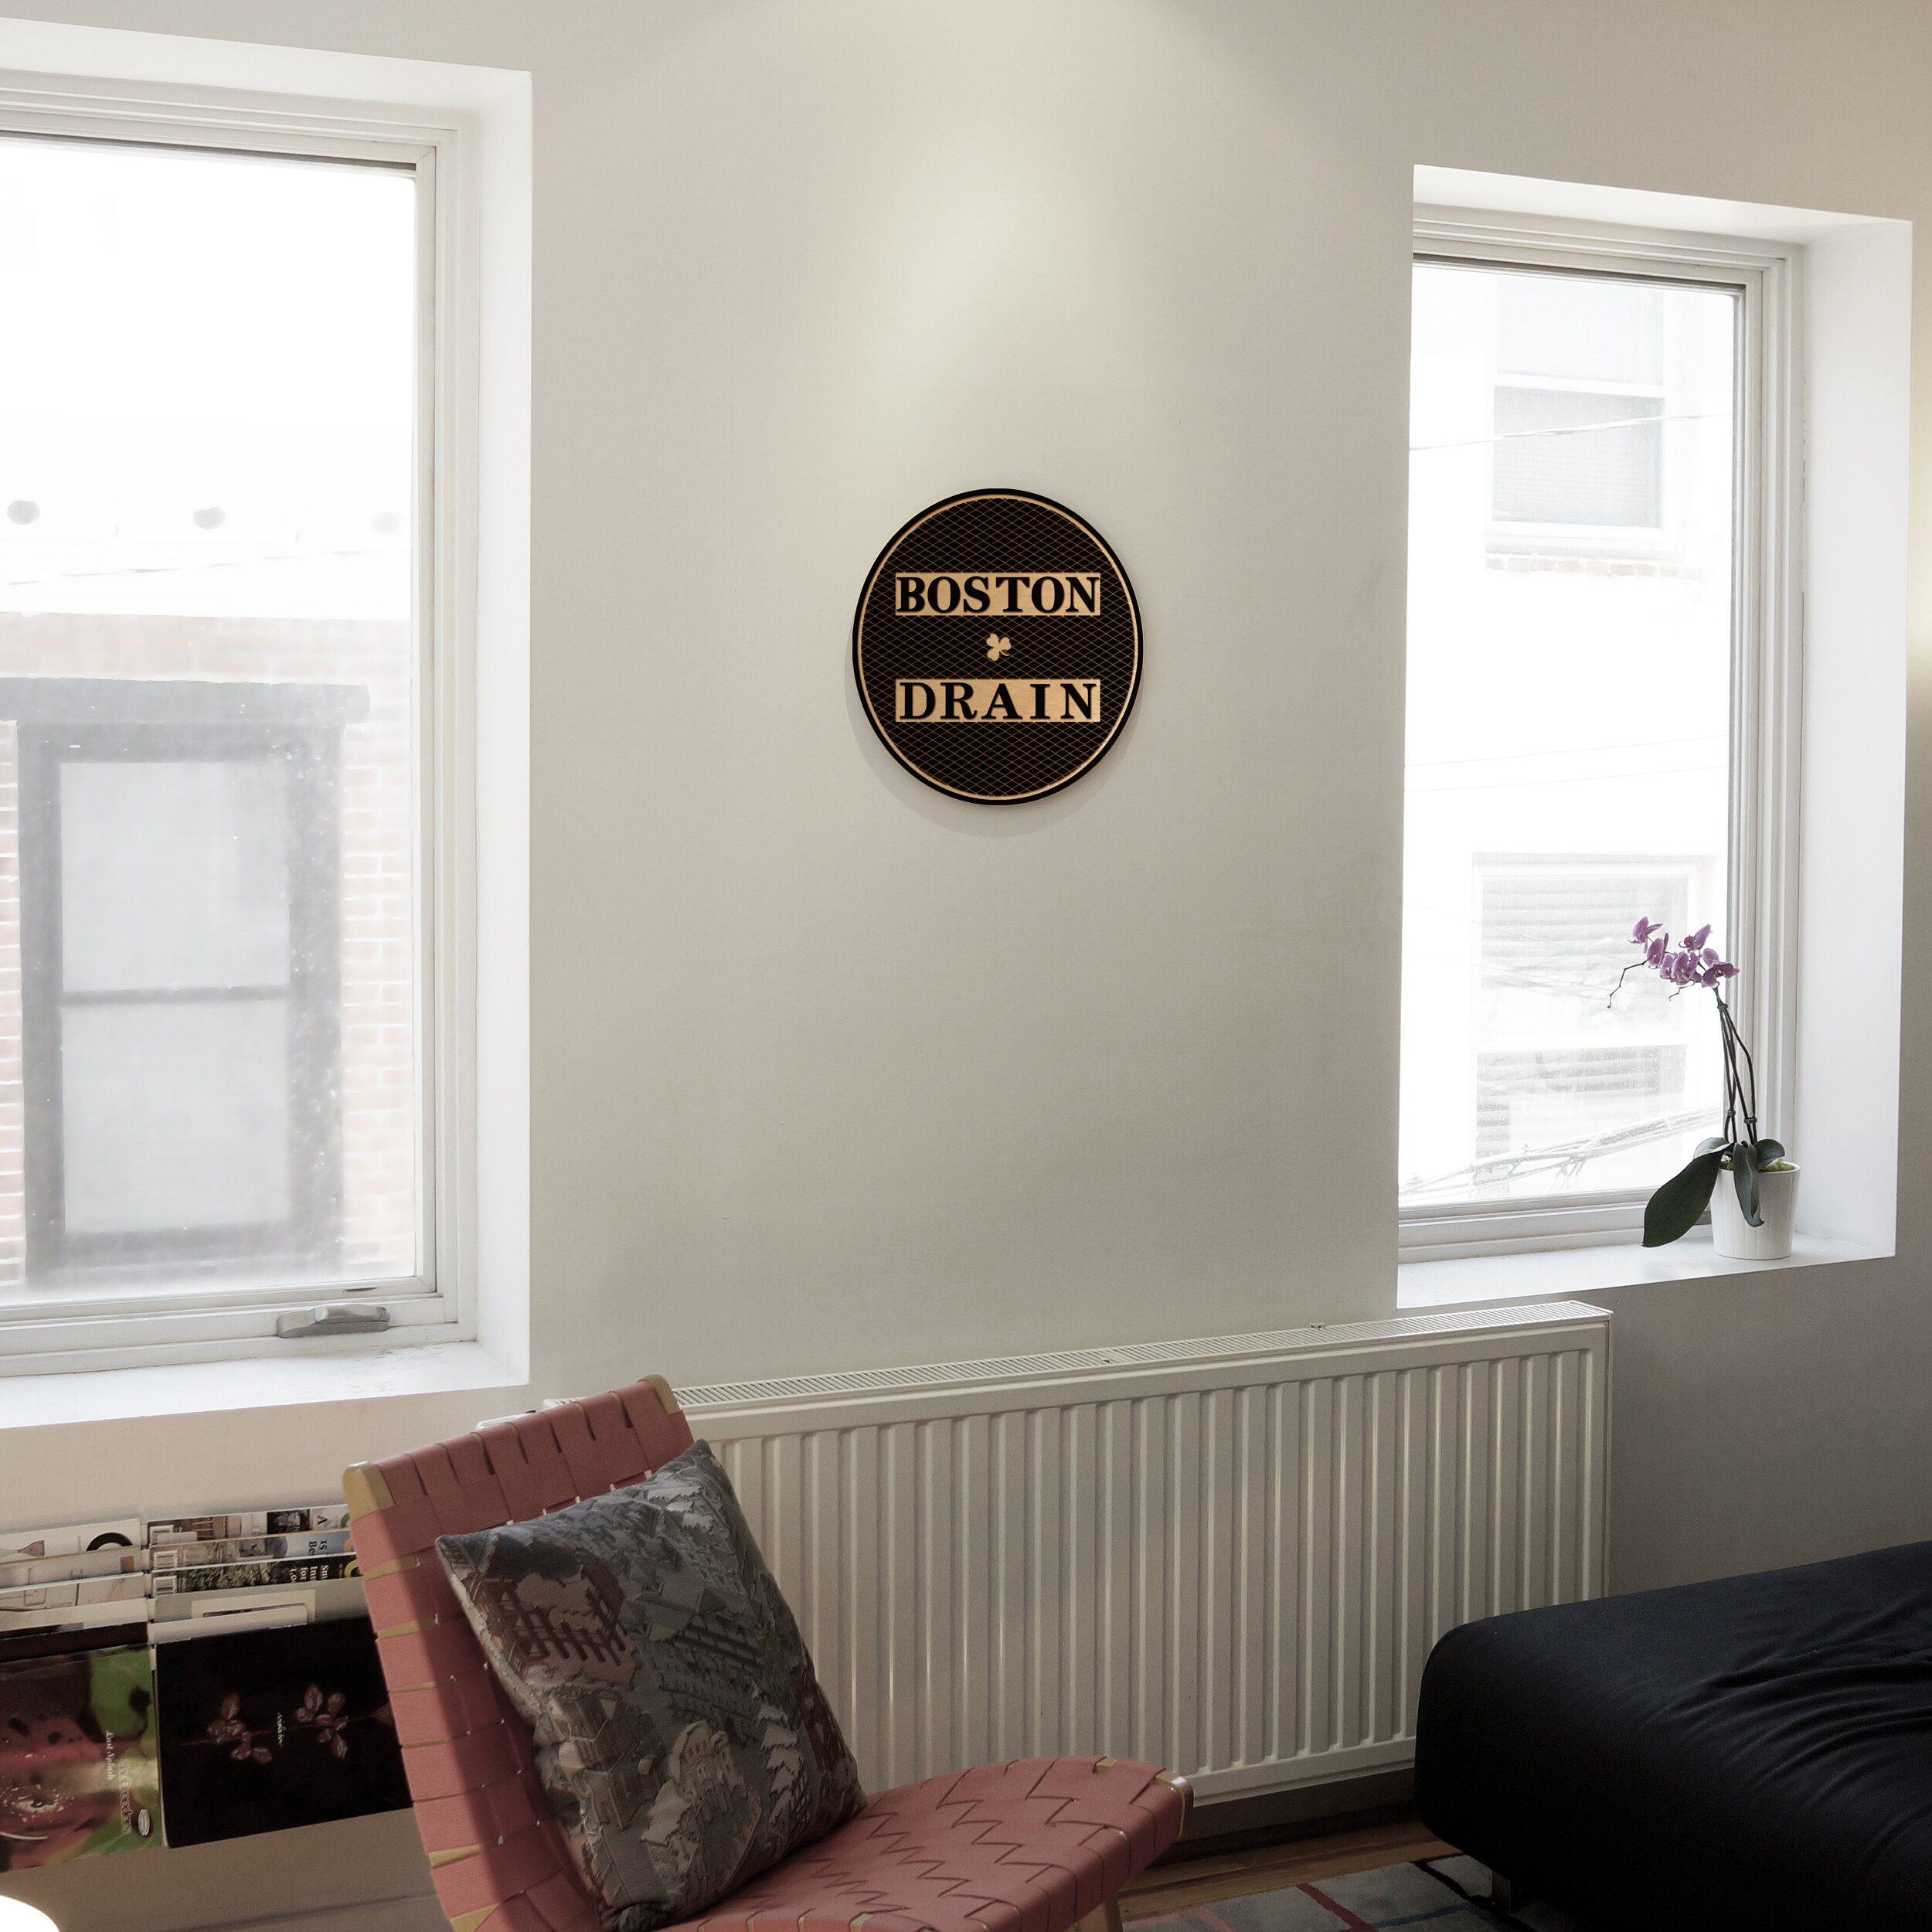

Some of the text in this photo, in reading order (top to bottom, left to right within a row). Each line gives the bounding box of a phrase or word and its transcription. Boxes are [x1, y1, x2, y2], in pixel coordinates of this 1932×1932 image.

[896, 576, 1100, 613] BOSTON
[899, 682, 1097, 720] DRAIN
[318, 1515, 328, 1525] A
